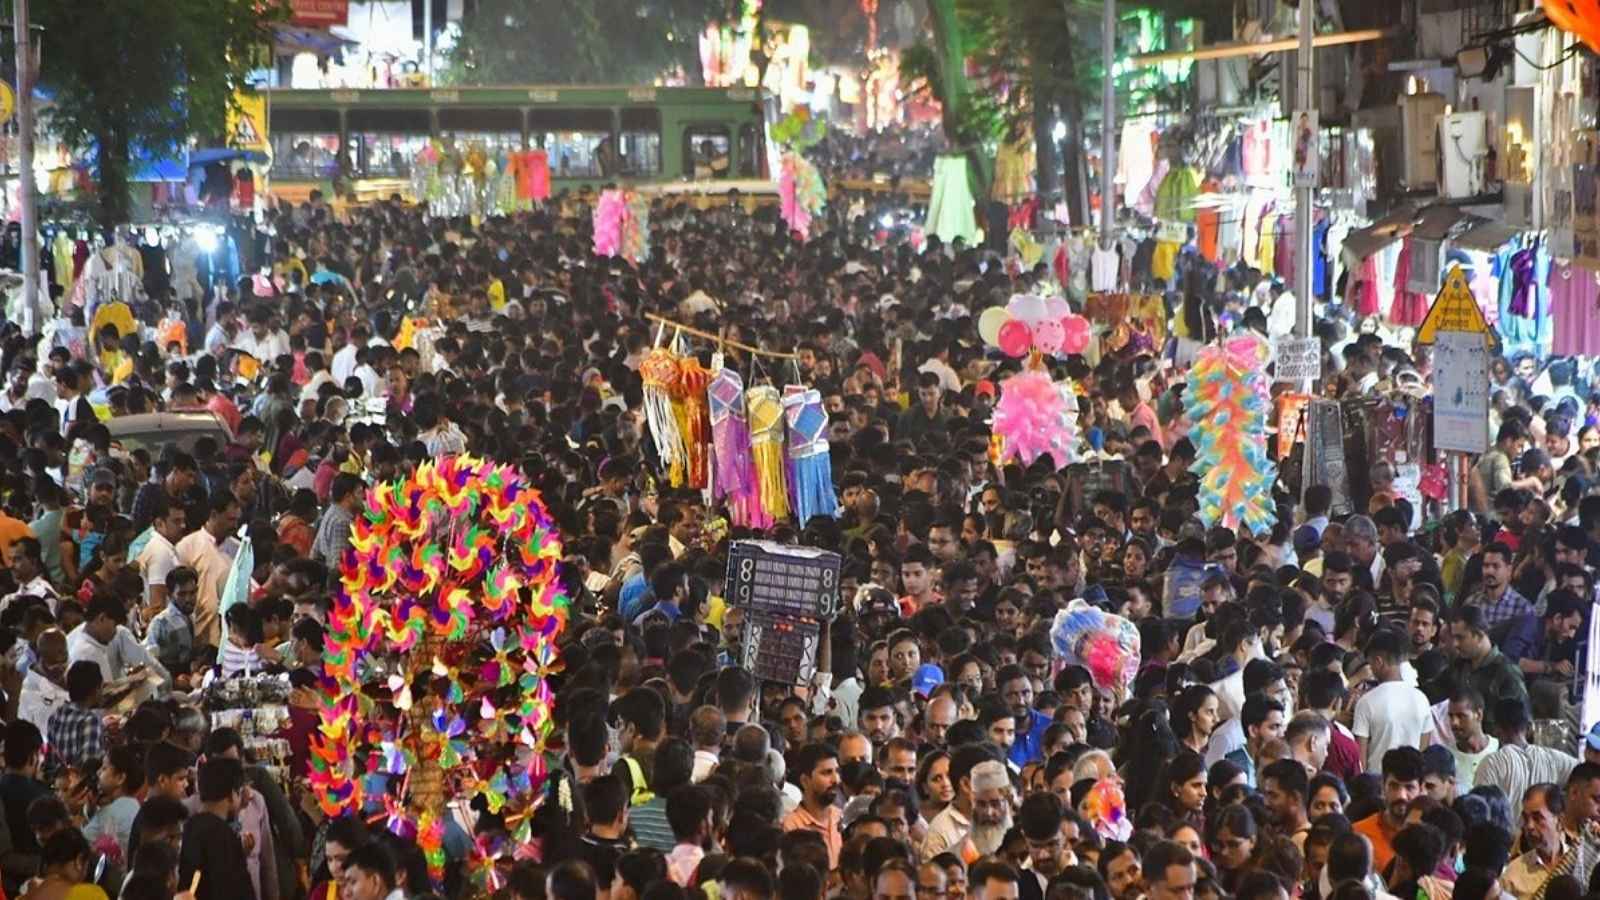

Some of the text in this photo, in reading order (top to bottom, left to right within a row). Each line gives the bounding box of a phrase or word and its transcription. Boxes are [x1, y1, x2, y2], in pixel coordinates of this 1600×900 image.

[741, 558, 753, 582] 8
[823, 568, 833, 588] 8
[820, 593, 831, 615] 9
